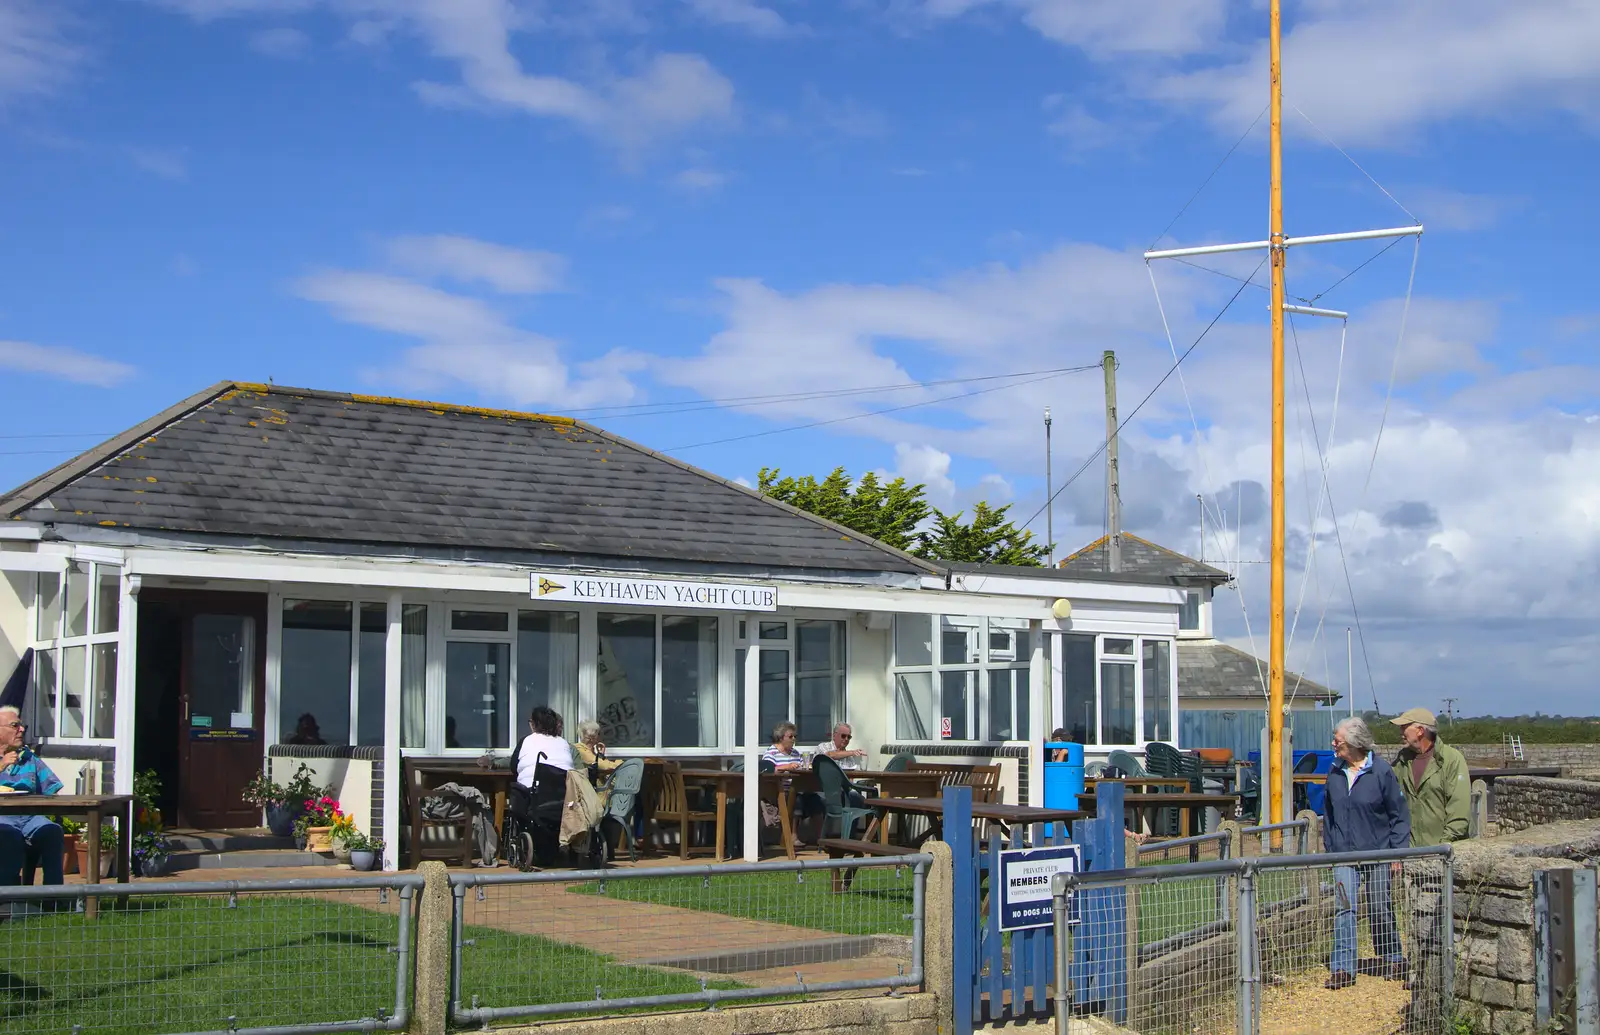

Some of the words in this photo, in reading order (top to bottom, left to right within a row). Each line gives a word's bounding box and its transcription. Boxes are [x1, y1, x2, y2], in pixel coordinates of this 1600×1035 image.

[573, 580, 666, 600] KEYHAVEN
[674, 586, 729, 603] YACHT
[731, 589, 773, 606] CLUB
[1023, 866, 1044, 875] PRIVATE
[1010, 876, 1048, 887] MEMBERS
[1012, 910, 1021, 918] NO
[1023, 908, 1040, 916] DOGS
